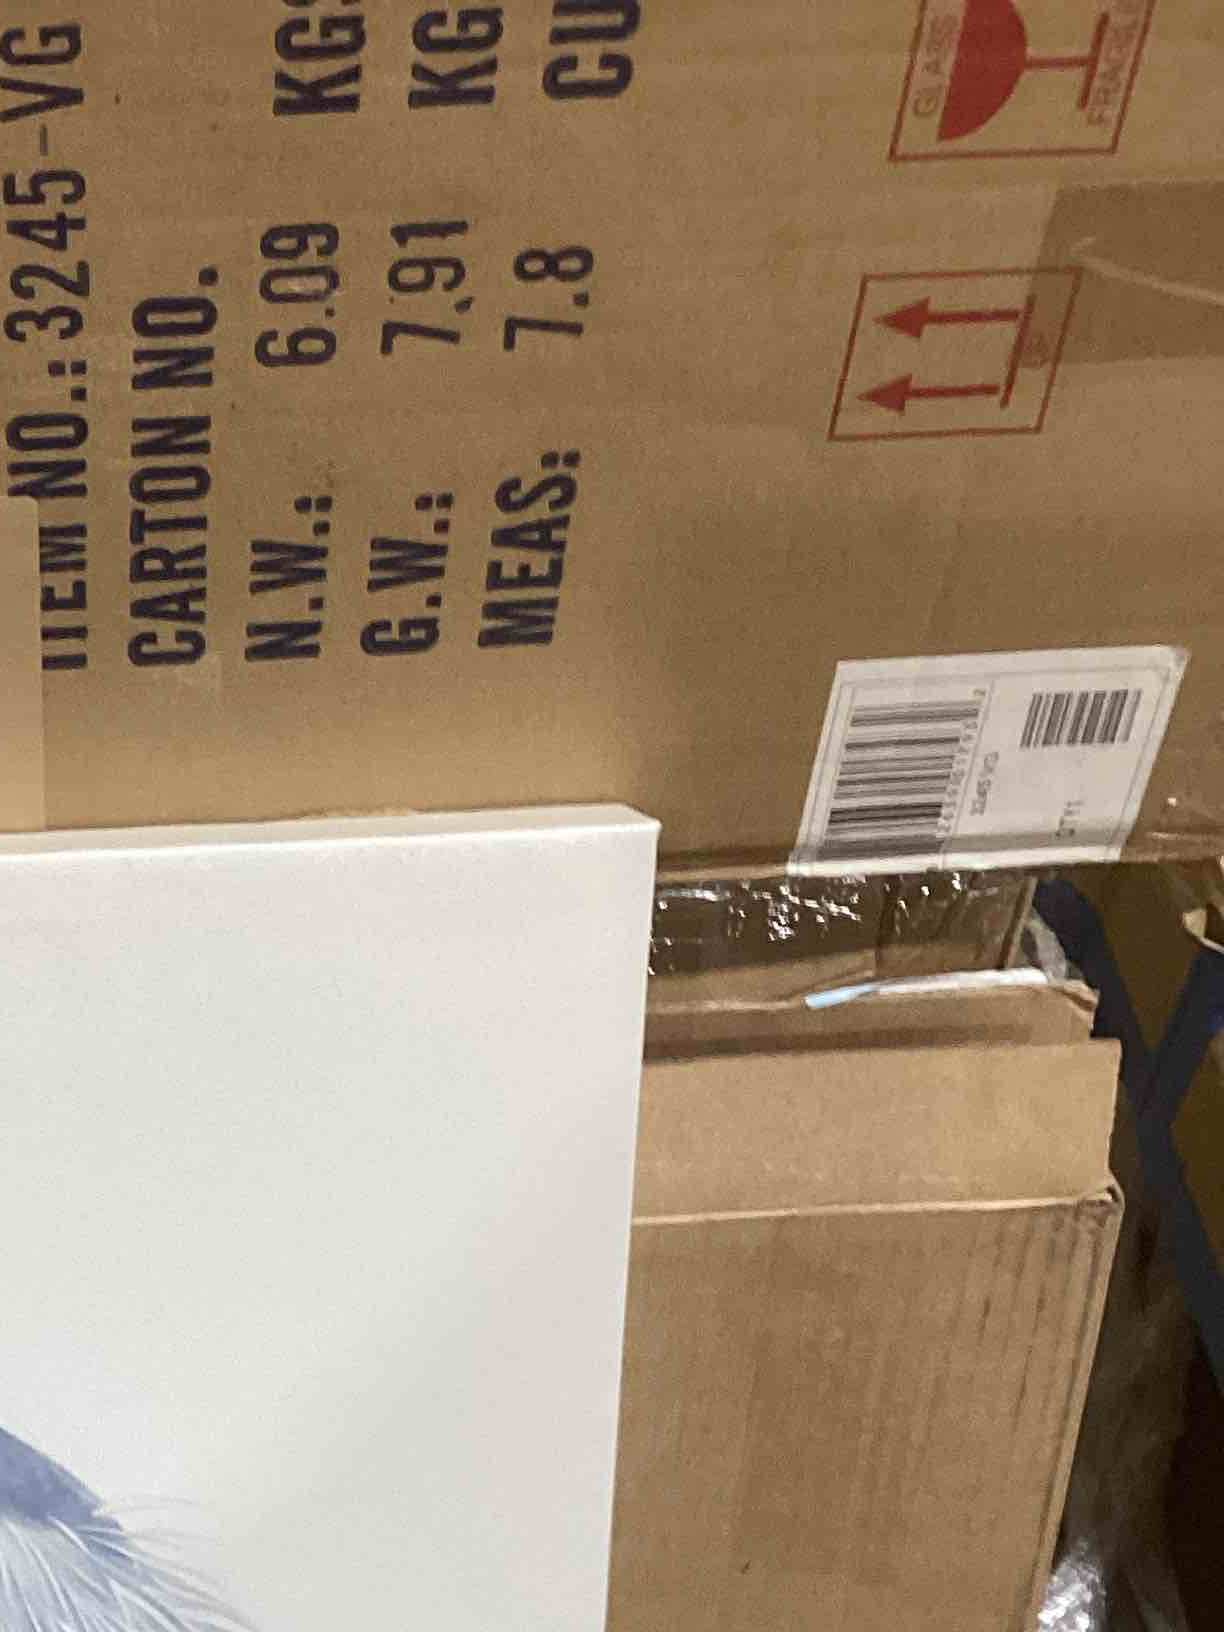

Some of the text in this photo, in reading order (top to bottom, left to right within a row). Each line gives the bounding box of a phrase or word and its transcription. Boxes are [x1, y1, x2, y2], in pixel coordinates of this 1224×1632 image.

[127, 265, 219, 667] CARTON NO.
[243, 0, 367, 663] N.W.: 6.09 KG
[360, 7, 504, 657] G.W.: 7.91 KG
[503, 245, 594, 351] 7.8
[478, 448, 581, 649] MEAS:
